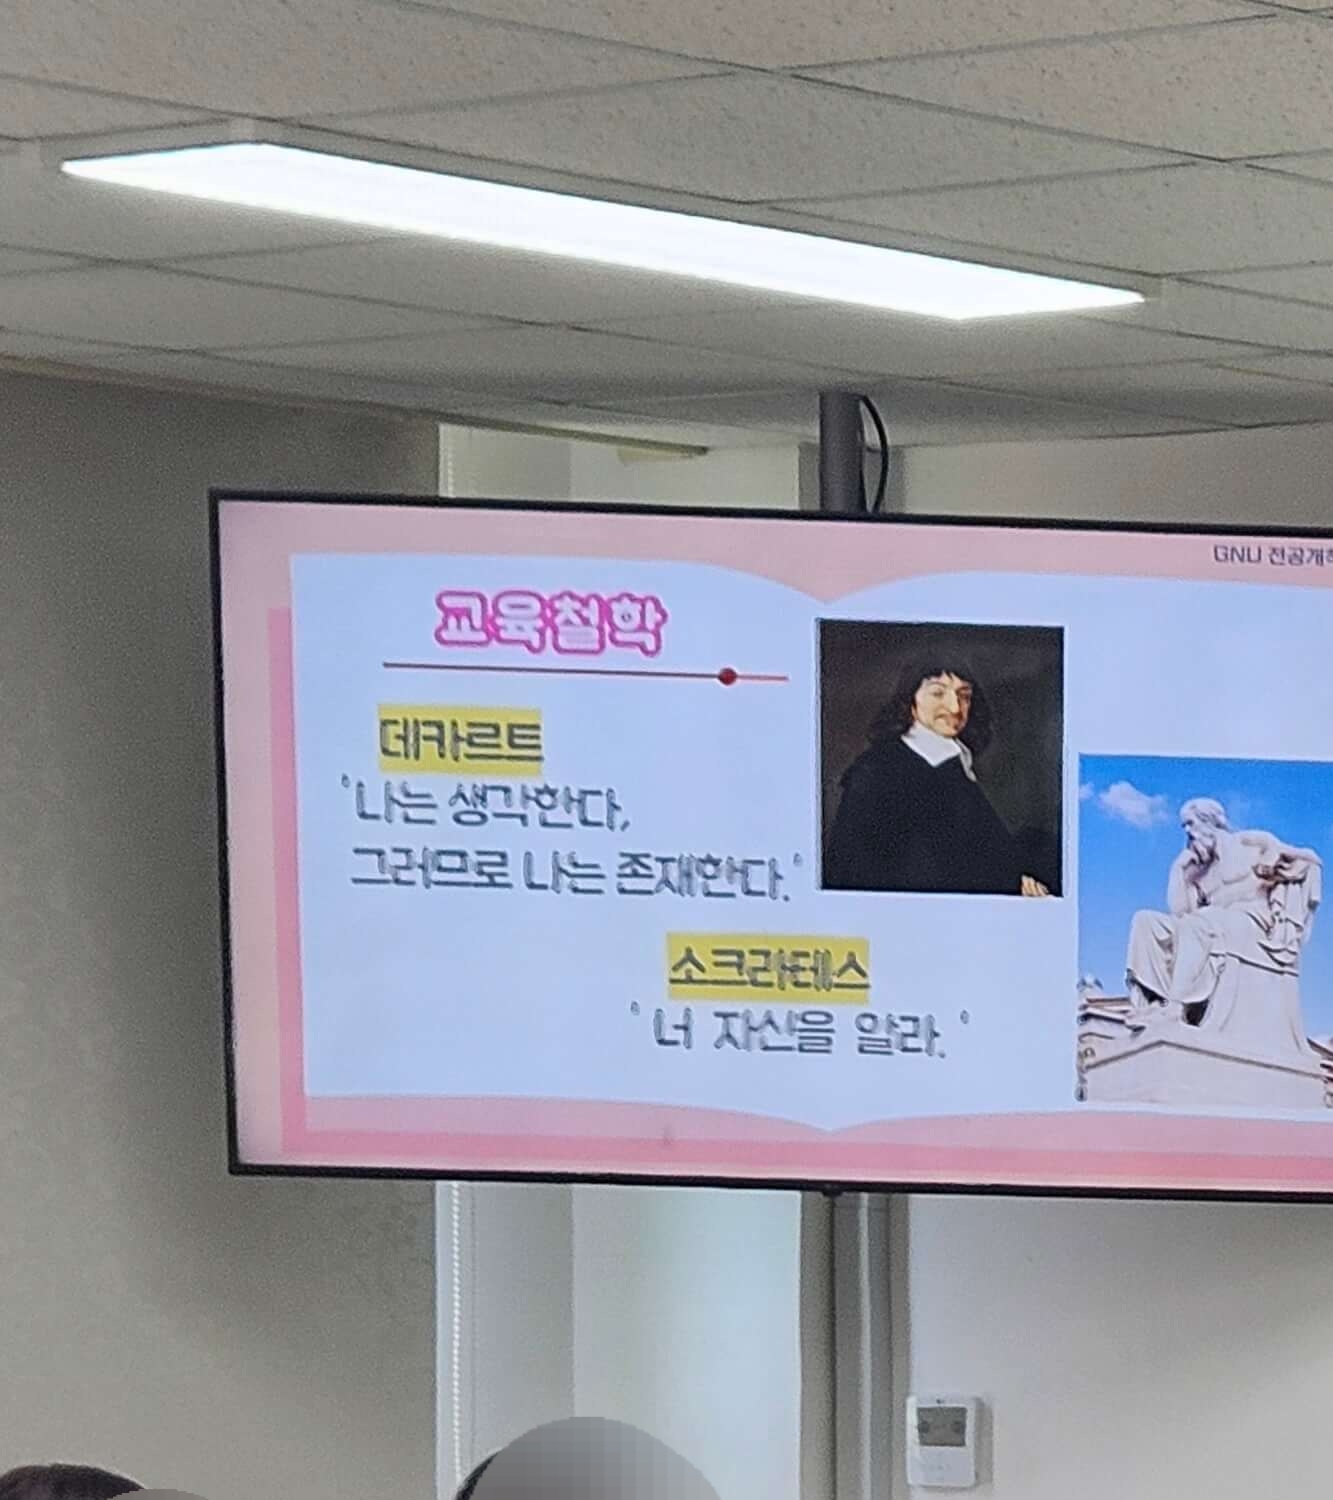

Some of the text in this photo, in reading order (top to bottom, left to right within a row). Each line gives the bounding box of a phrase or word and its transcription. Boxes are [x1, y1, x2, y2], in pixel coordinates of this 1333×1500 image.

[1213, 545, 1262, 563] GNU
[435, 591, 668, 657] 교육철학
[379, 717, 544, 762] 데카르트
[449, 783, 631, 831] 생각한다,
[352, 846, 513, 889] 그러므로
[523, 851, 605, 895] 나는
[669, 946, 871, 991] 소크라테스
[713, 1009, 835, 1054] 자신을
